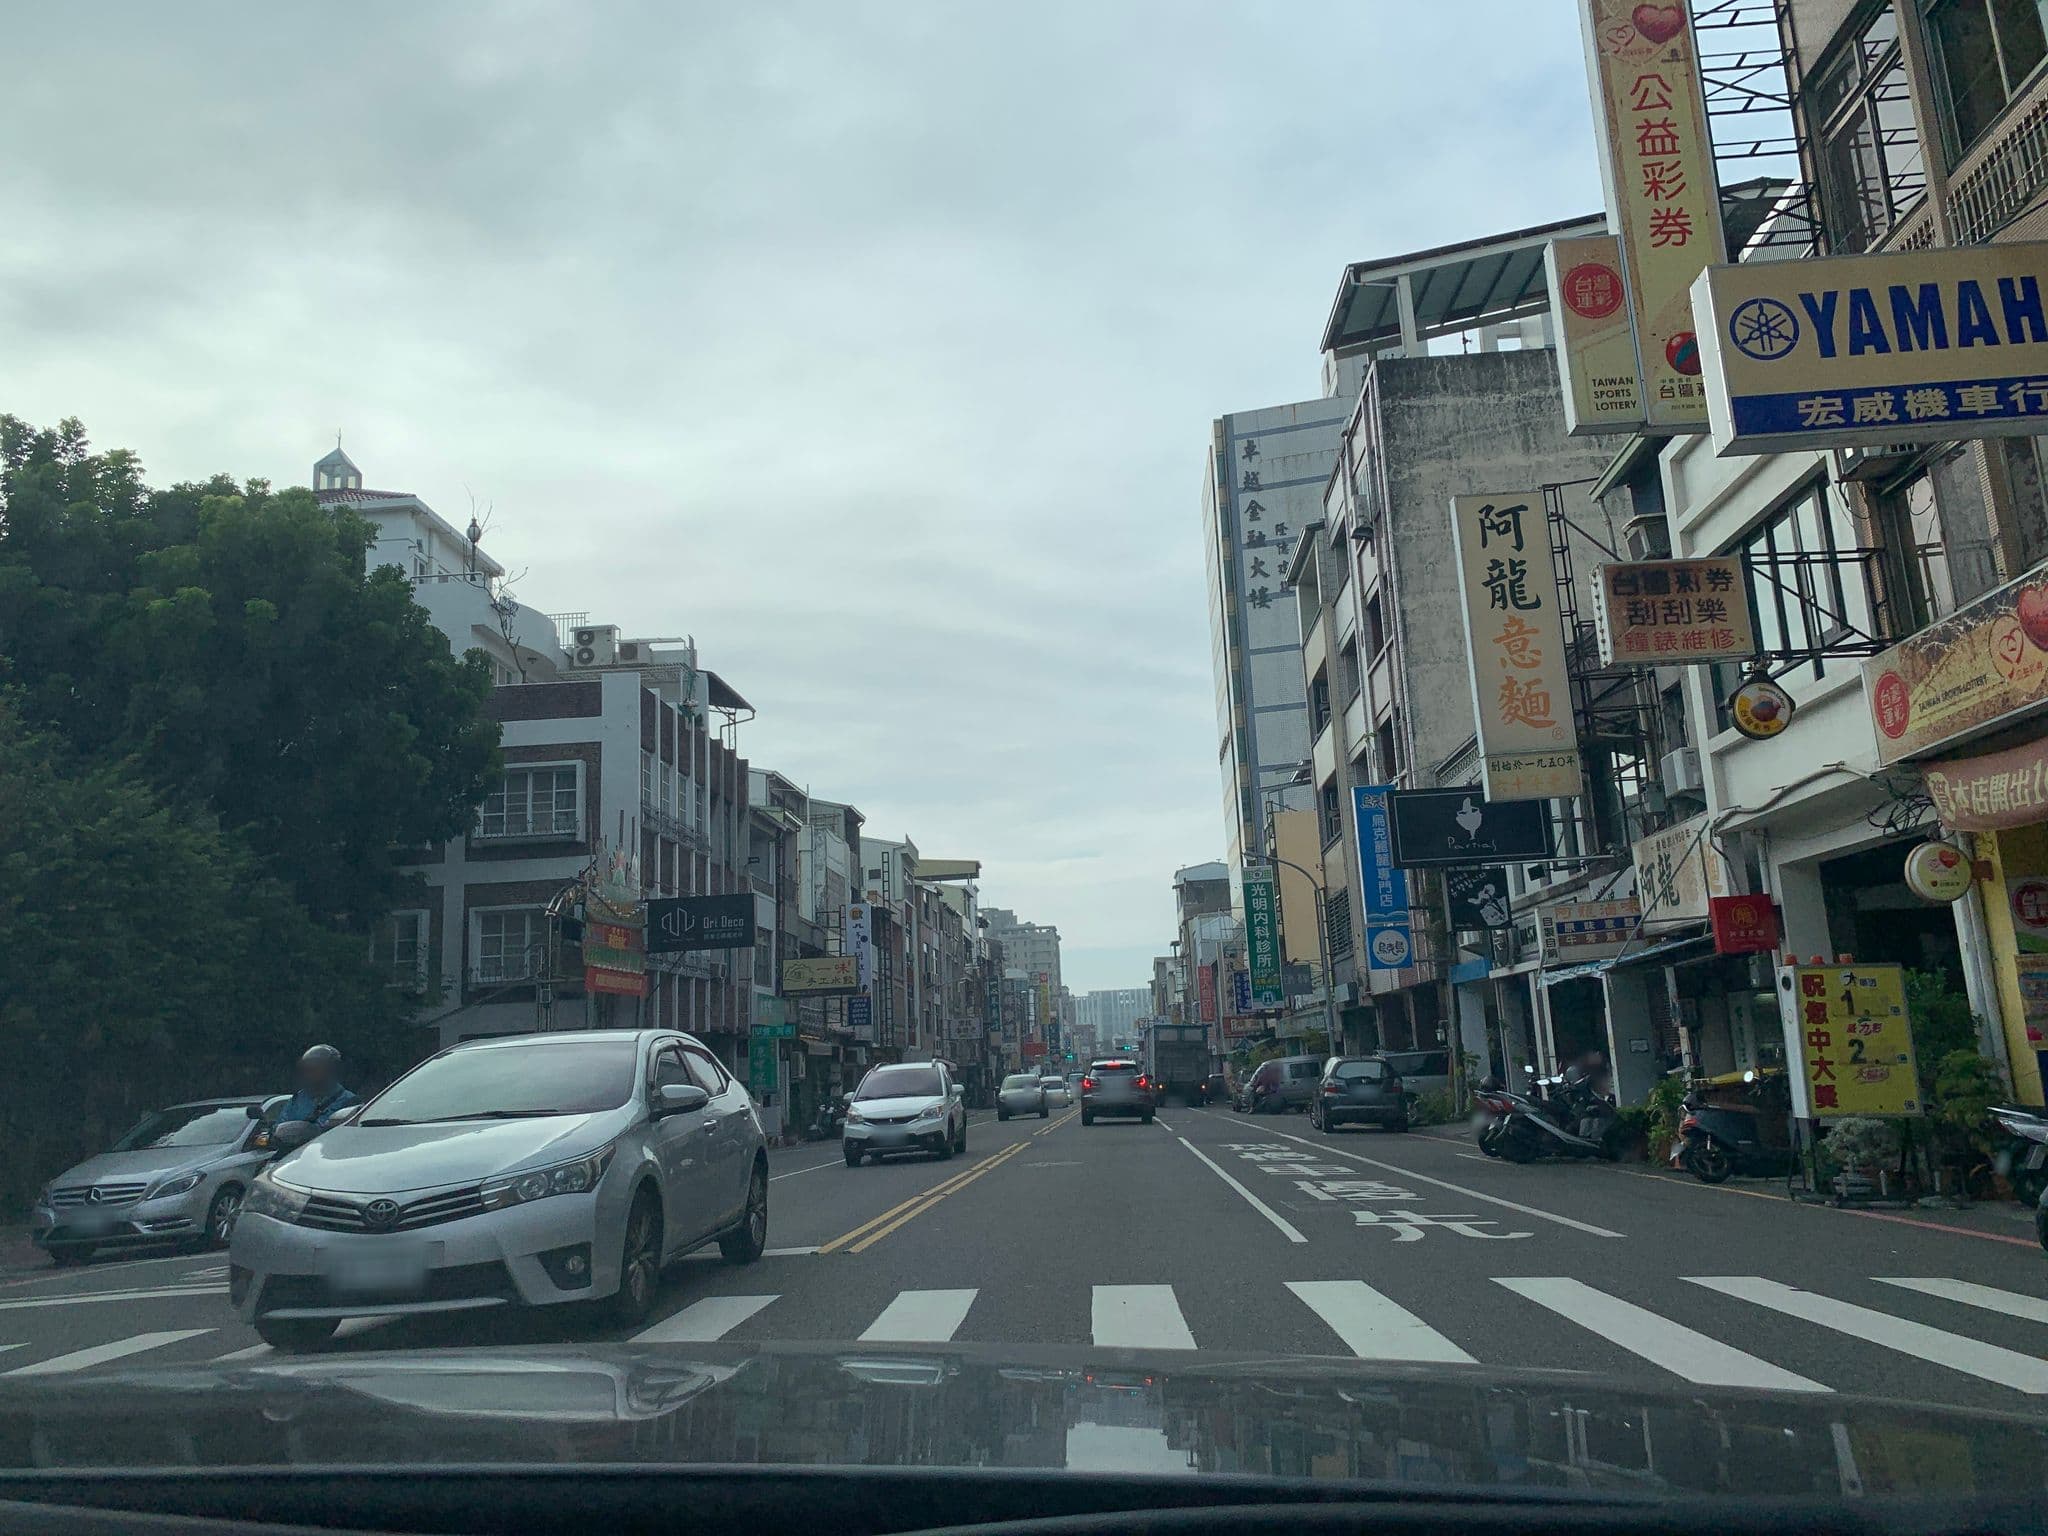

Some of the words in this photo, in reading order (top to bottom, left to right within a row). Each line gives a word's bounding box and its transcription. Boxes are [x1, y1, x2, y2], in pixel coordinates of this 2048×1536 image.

[1630, 73, 1693, 249] 公益彩券
[1798, 276, 2048, 359] YAMAH
[1592, 377, 1634, 388] TAIWAN
[1594, 389, 1632, 399] SPORTS
[1596, 400, 1637, 411] LOTTERY
[1799, 380, 2048, 428] 宏威機車行
[1478, 504, 1557, 729] 阿龍意麵
[1626, 598, 1728, 626] 刮刮樂
[1624, 628, 1736, 653] 鐘錶維修
[1952, 759, 2048, 816] 本店開出1
[1251, 884, 1272, 968] 光明內科診所
